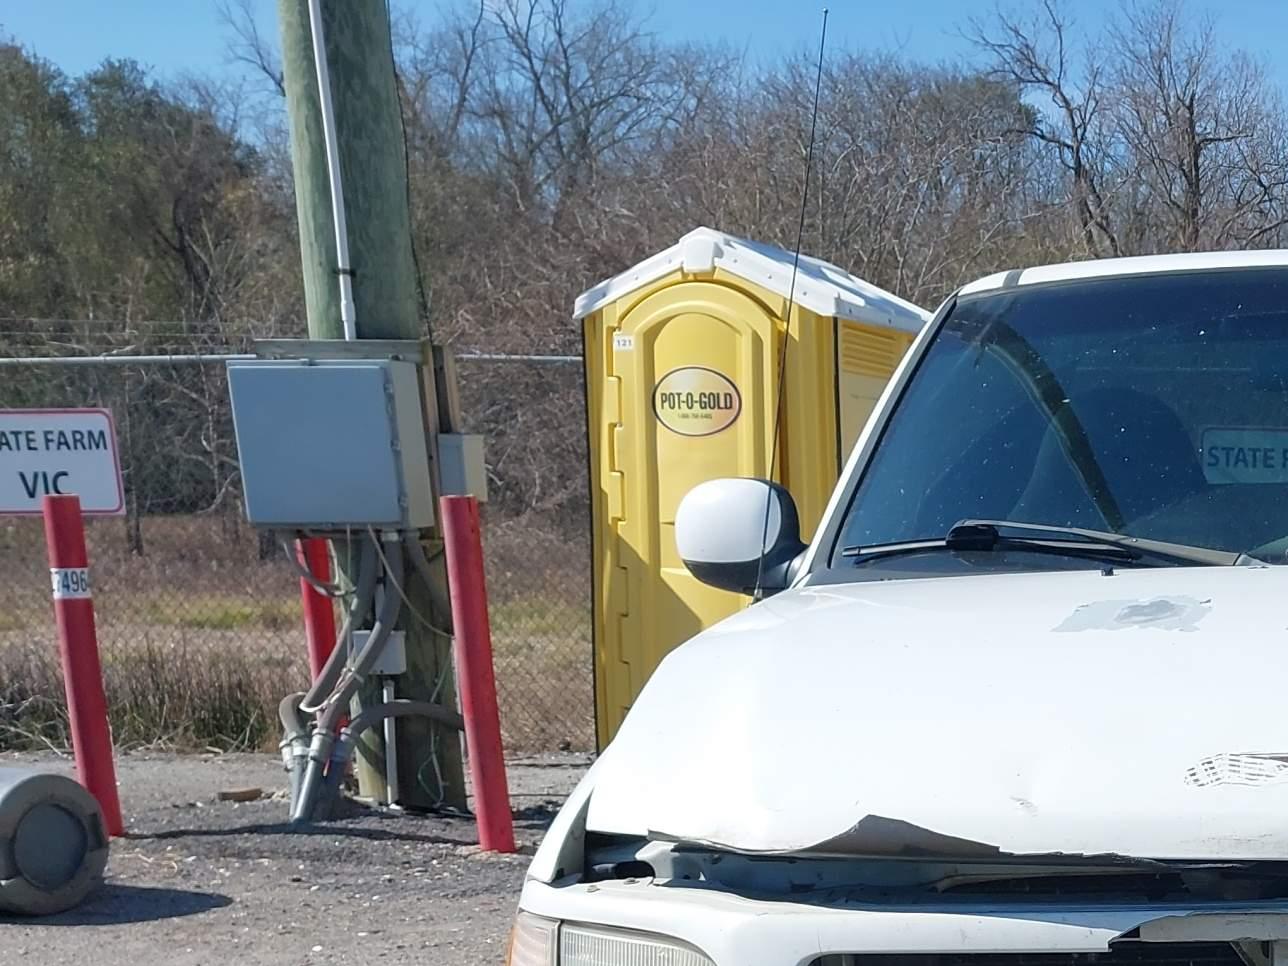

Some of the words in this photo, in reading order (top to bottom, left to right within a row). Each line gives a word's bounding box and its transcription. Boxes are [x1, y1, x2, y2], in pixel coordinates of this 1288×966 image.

[660, 392, 733, 410] POT-O-GOLD
[42, 429, 108, 451] FARM
[1207, 446, 1275, 468] STATE
[18, 471, 69, 498] VIC
